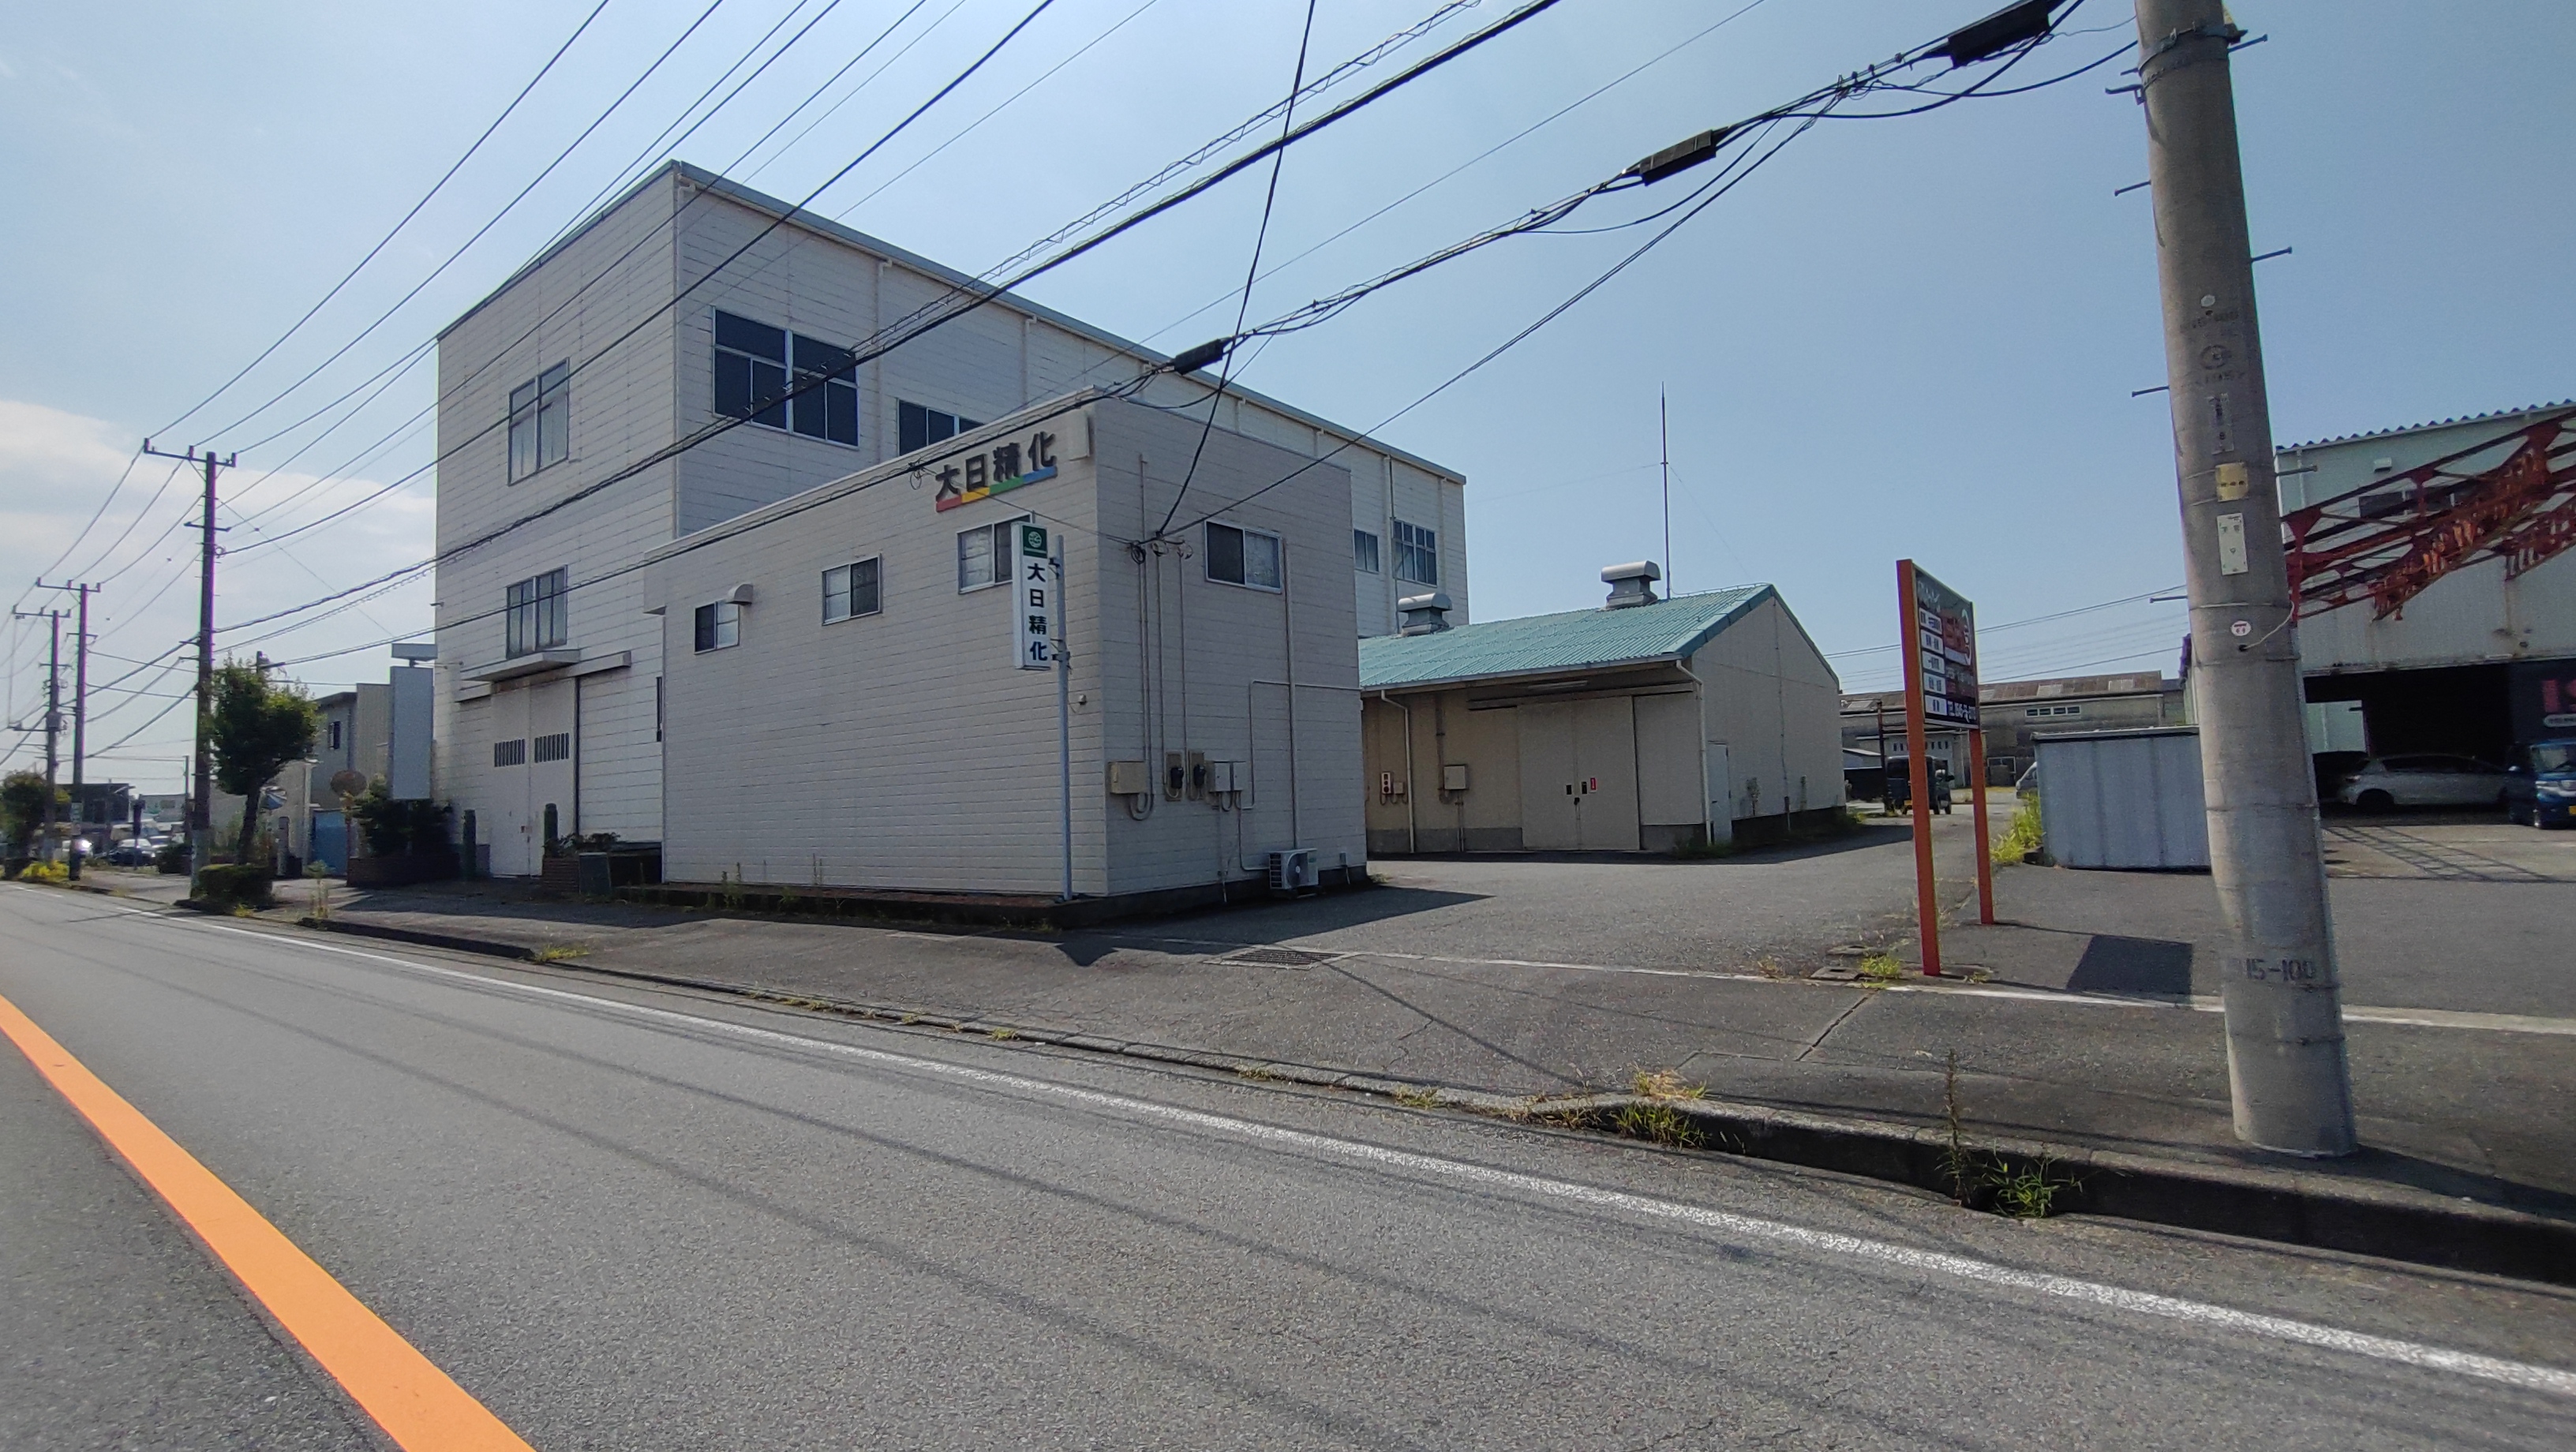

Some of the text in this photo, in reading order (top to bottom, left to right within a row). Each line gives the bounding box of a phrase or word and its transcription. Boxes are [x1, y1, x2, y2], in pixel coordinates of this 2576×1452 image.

[935, 431, 1057, 501] 大日精化
[1027, 563, 1048, 661] 大日精化
